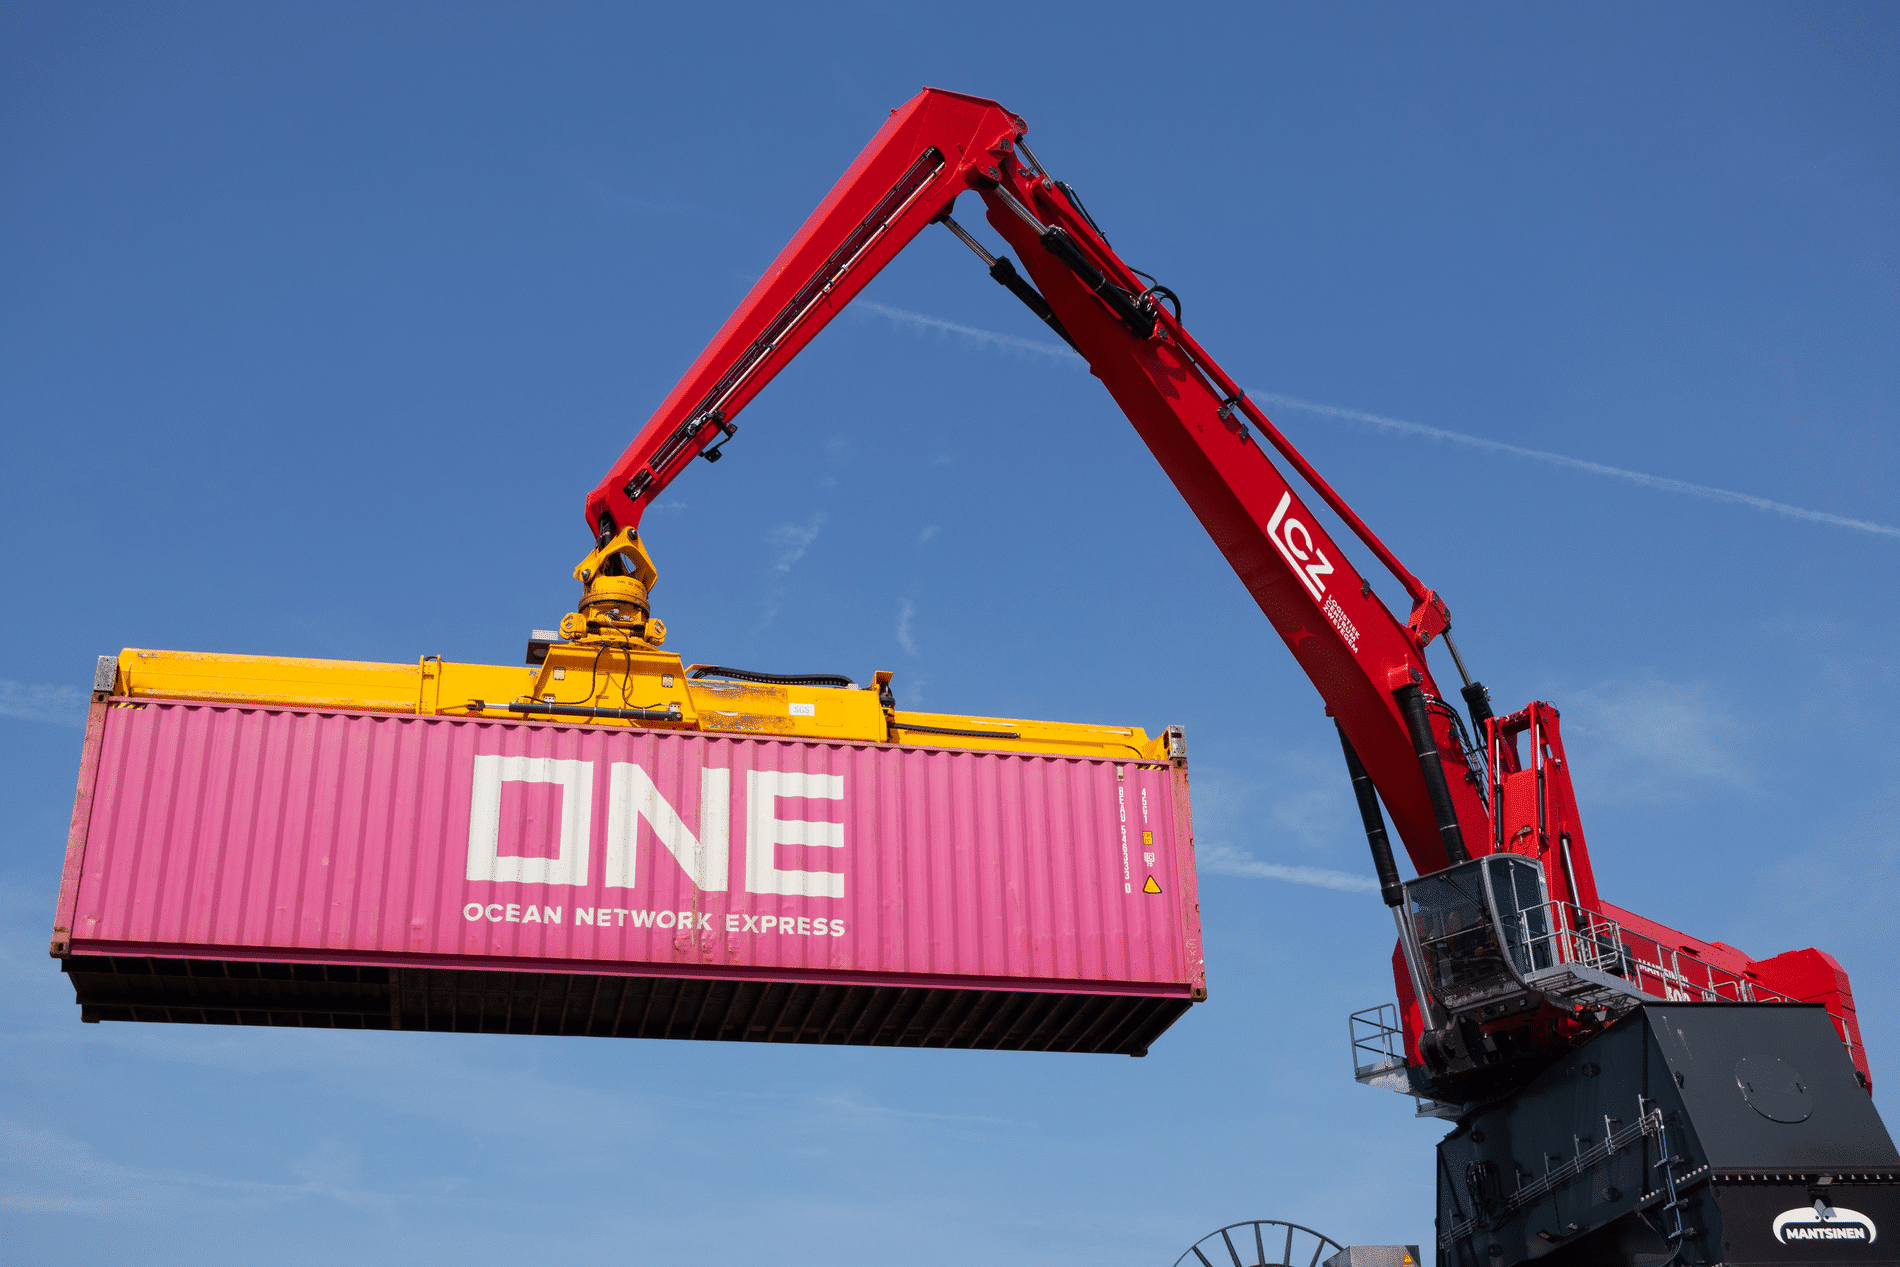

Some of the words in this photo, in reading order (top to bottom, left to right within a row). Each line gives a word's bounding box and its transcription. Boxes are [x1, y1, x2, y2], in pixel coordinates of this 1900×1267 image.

[1322, 604, 1358, 653] ZWEVEGEM
[793, 705, 810, 714] SGS
[1118, 786, 1126, 822] BEAU
[466, 754, 845, 898] ONE
[463, 902, 562, 924] OCEAN
[575, 907, 713, 931] NETWORK
[725, 913, 846, 937] EXPRESS
[1785, 1227, 1866, 1239] MANTSINEN
